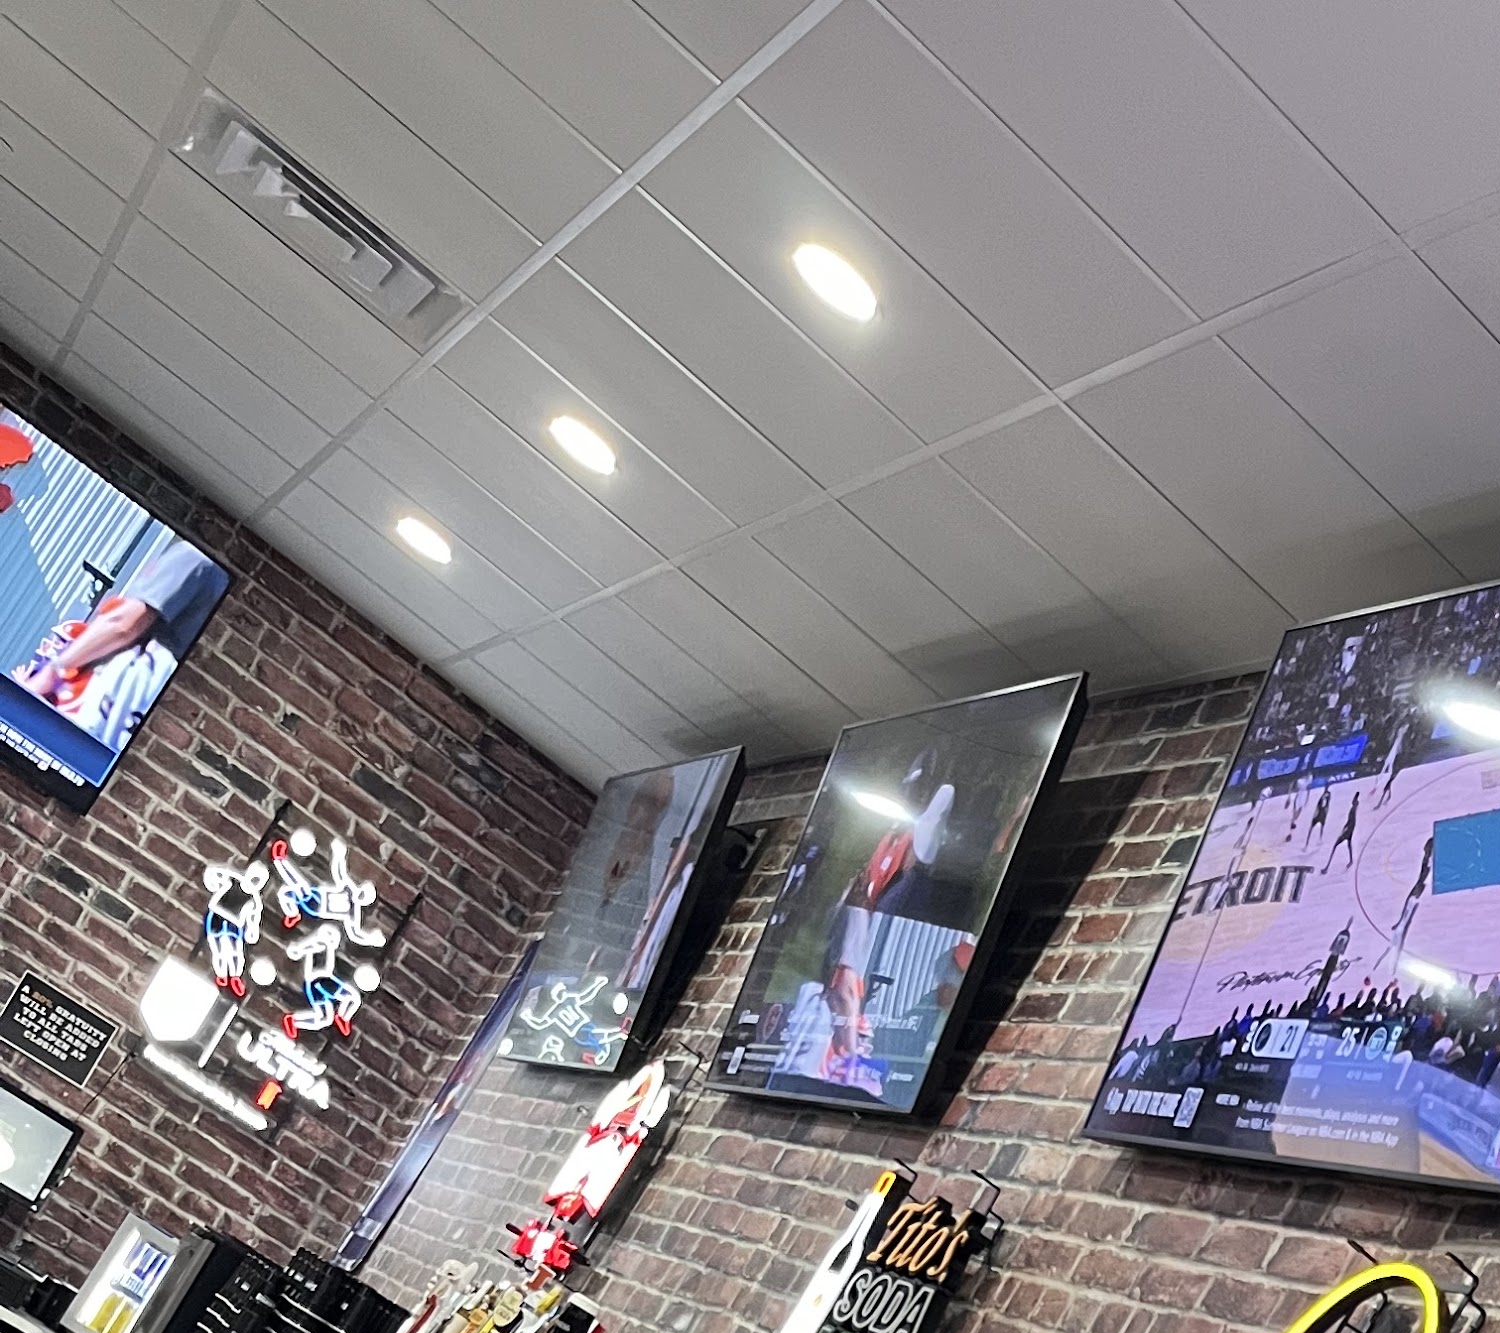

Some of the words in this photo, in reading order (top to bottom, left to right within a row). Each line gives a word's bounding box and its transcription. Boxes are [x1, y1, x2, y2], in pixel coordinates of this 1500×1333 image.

[13, 1012, 42, 1033] LEFT
[41, 1030, 71, 1052] OPEN
[69, 1049, 87, 1061] AT
[19, 993, 47, 1016] WILL
[48, 1012, 65, 1026] BE
[64, 1023, 100, 1049] ADDED
[21, 984, 31, 994] A
[54, 1005, 108, 1042] GRATUITY
[22, 1006, 37, 1020] TO
[37, 1017, 59, 1034] ALL
[60, 1030, 89, 1052] TABS
[23, 1029, 69, 1061] CLOSING
